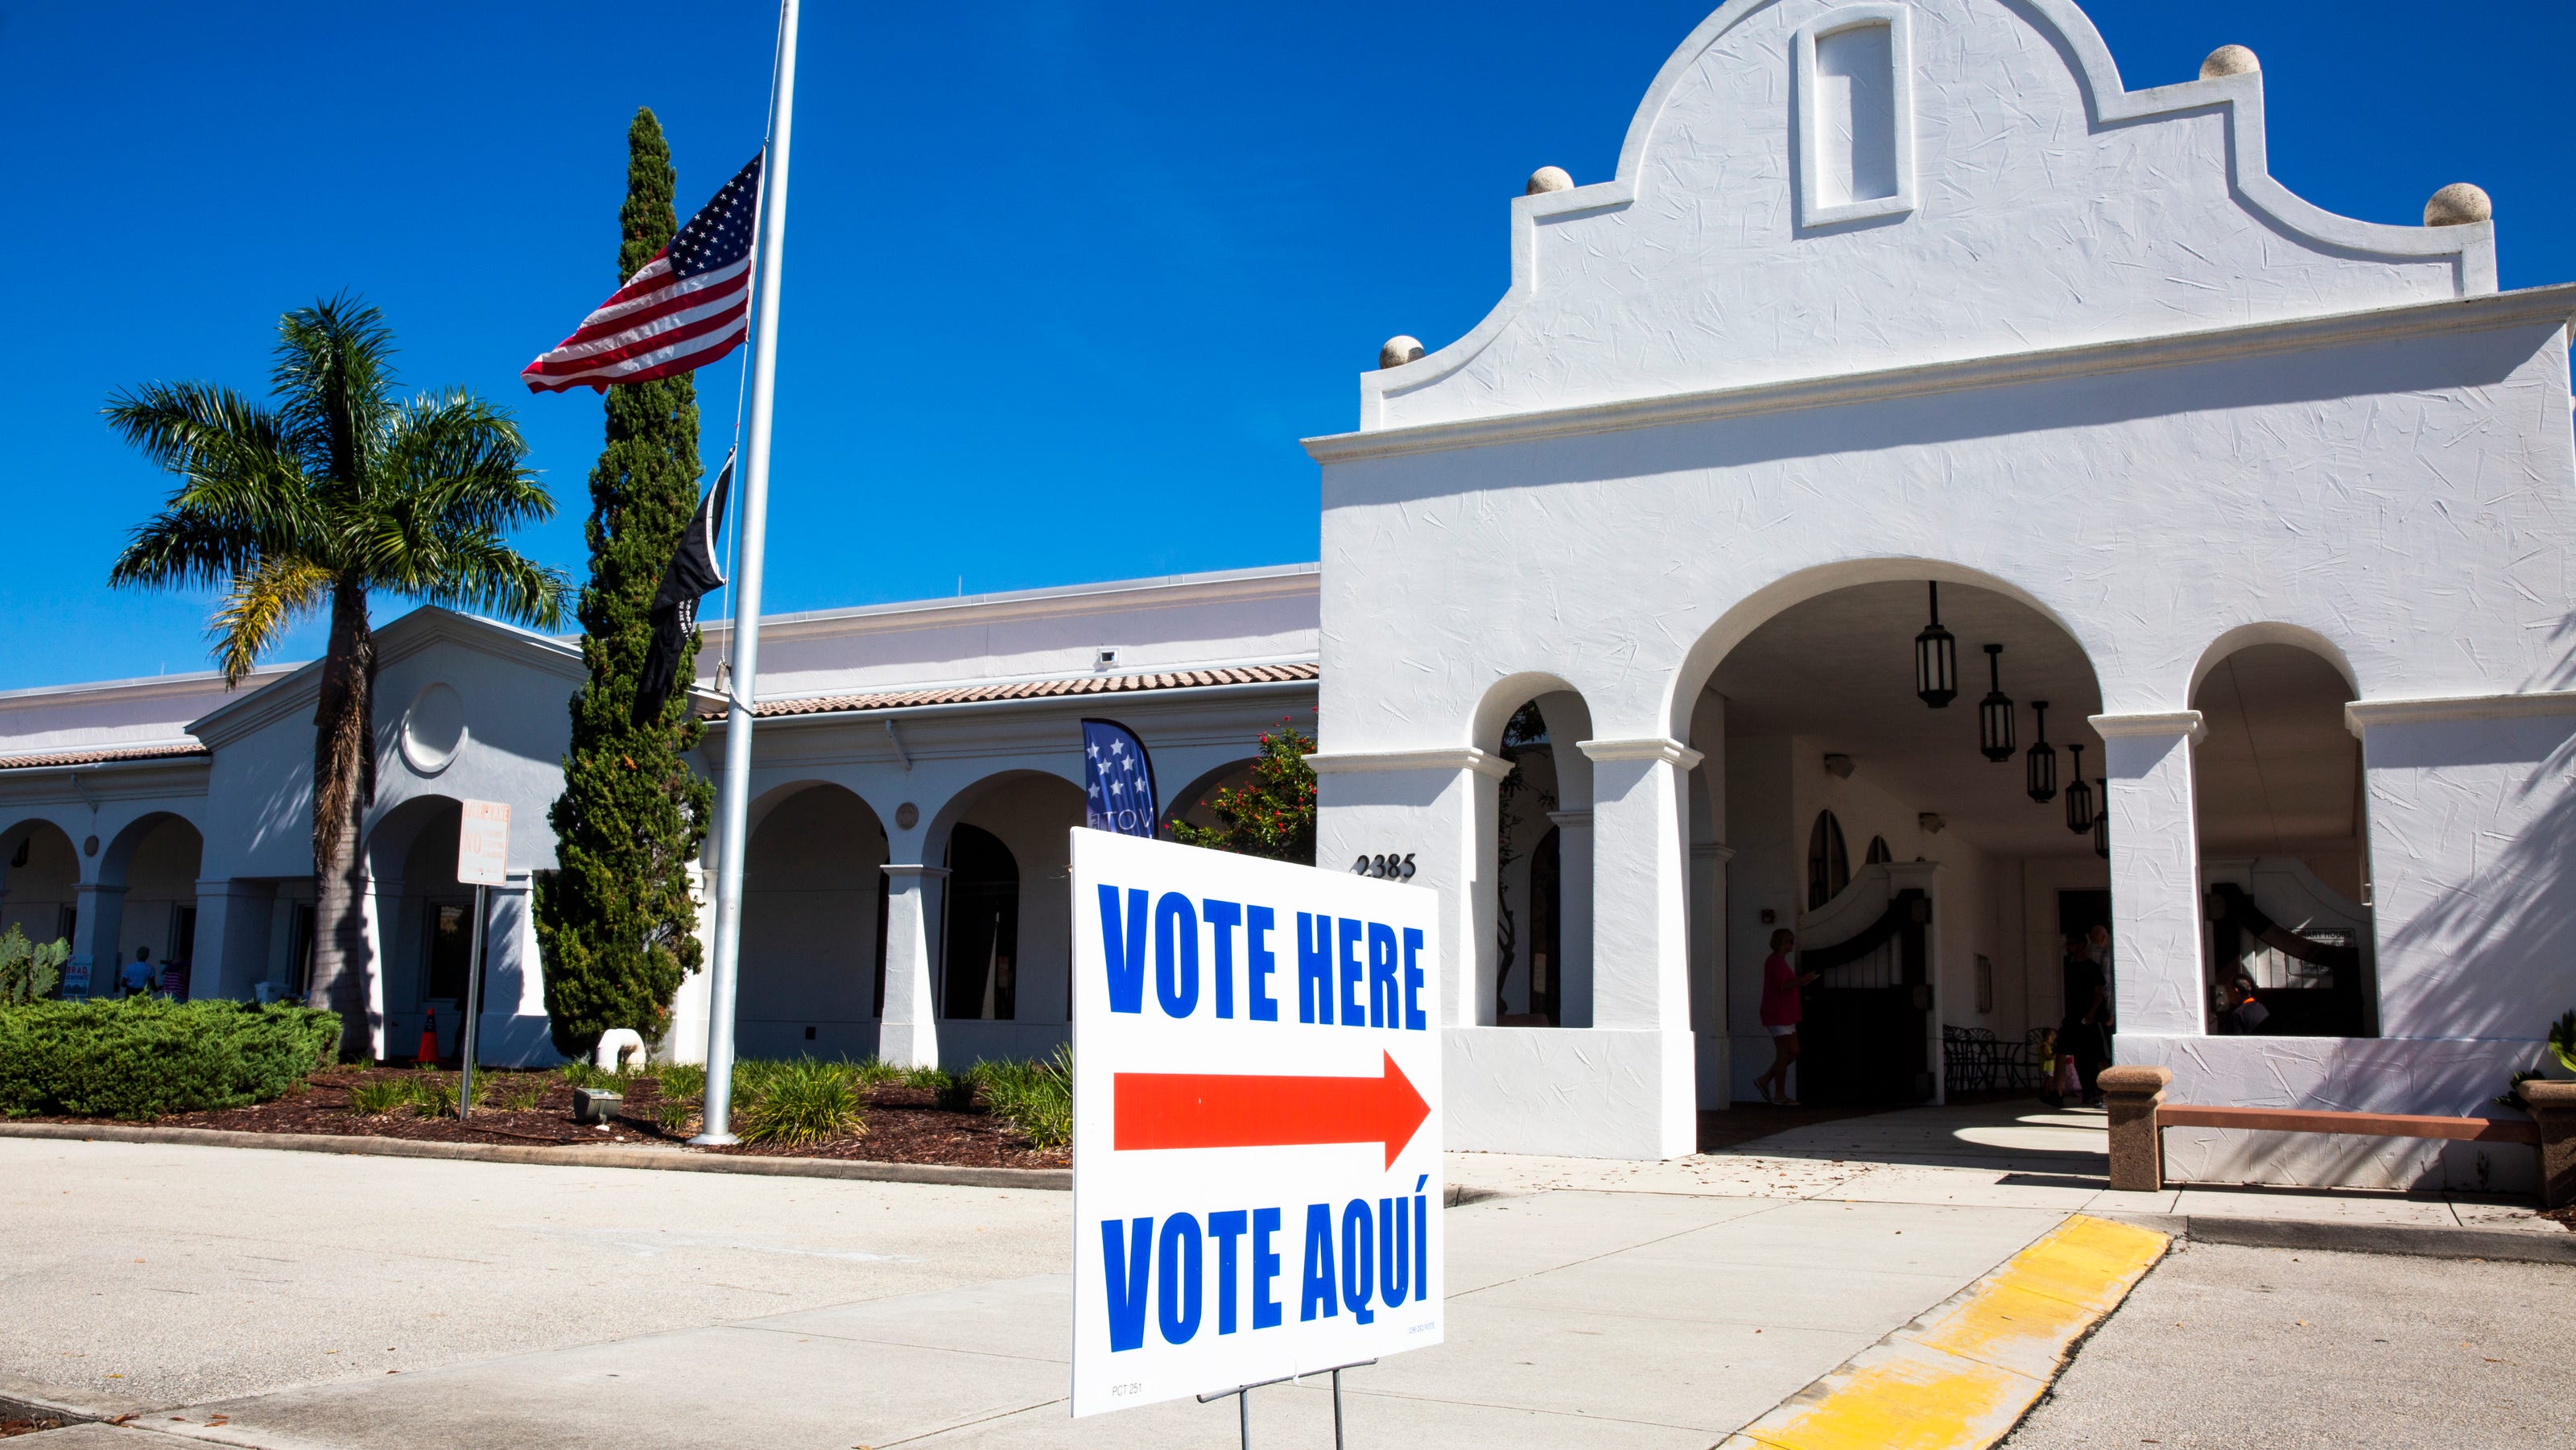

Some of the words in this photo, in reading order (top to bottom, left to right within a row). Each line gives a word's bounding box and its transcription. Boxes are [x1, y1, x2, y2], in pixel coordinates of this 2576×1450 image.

[1357, 853, 1416, 878] 2385
[2325, 930, 2351, 938] HOURS
[1097, 883, 1278, 1022] VOTE
[1296, 911, 1426, 1031] HERE
[67, 965, 88, 973] BRAD
[1100, 1207, 1282, 1353] VOTE
[1300, 1174, 1429, 1325] AQUÍ
[1113, 1384, 1128, 1396] PCT
[1129, 1382, 1141, 1394] 251
